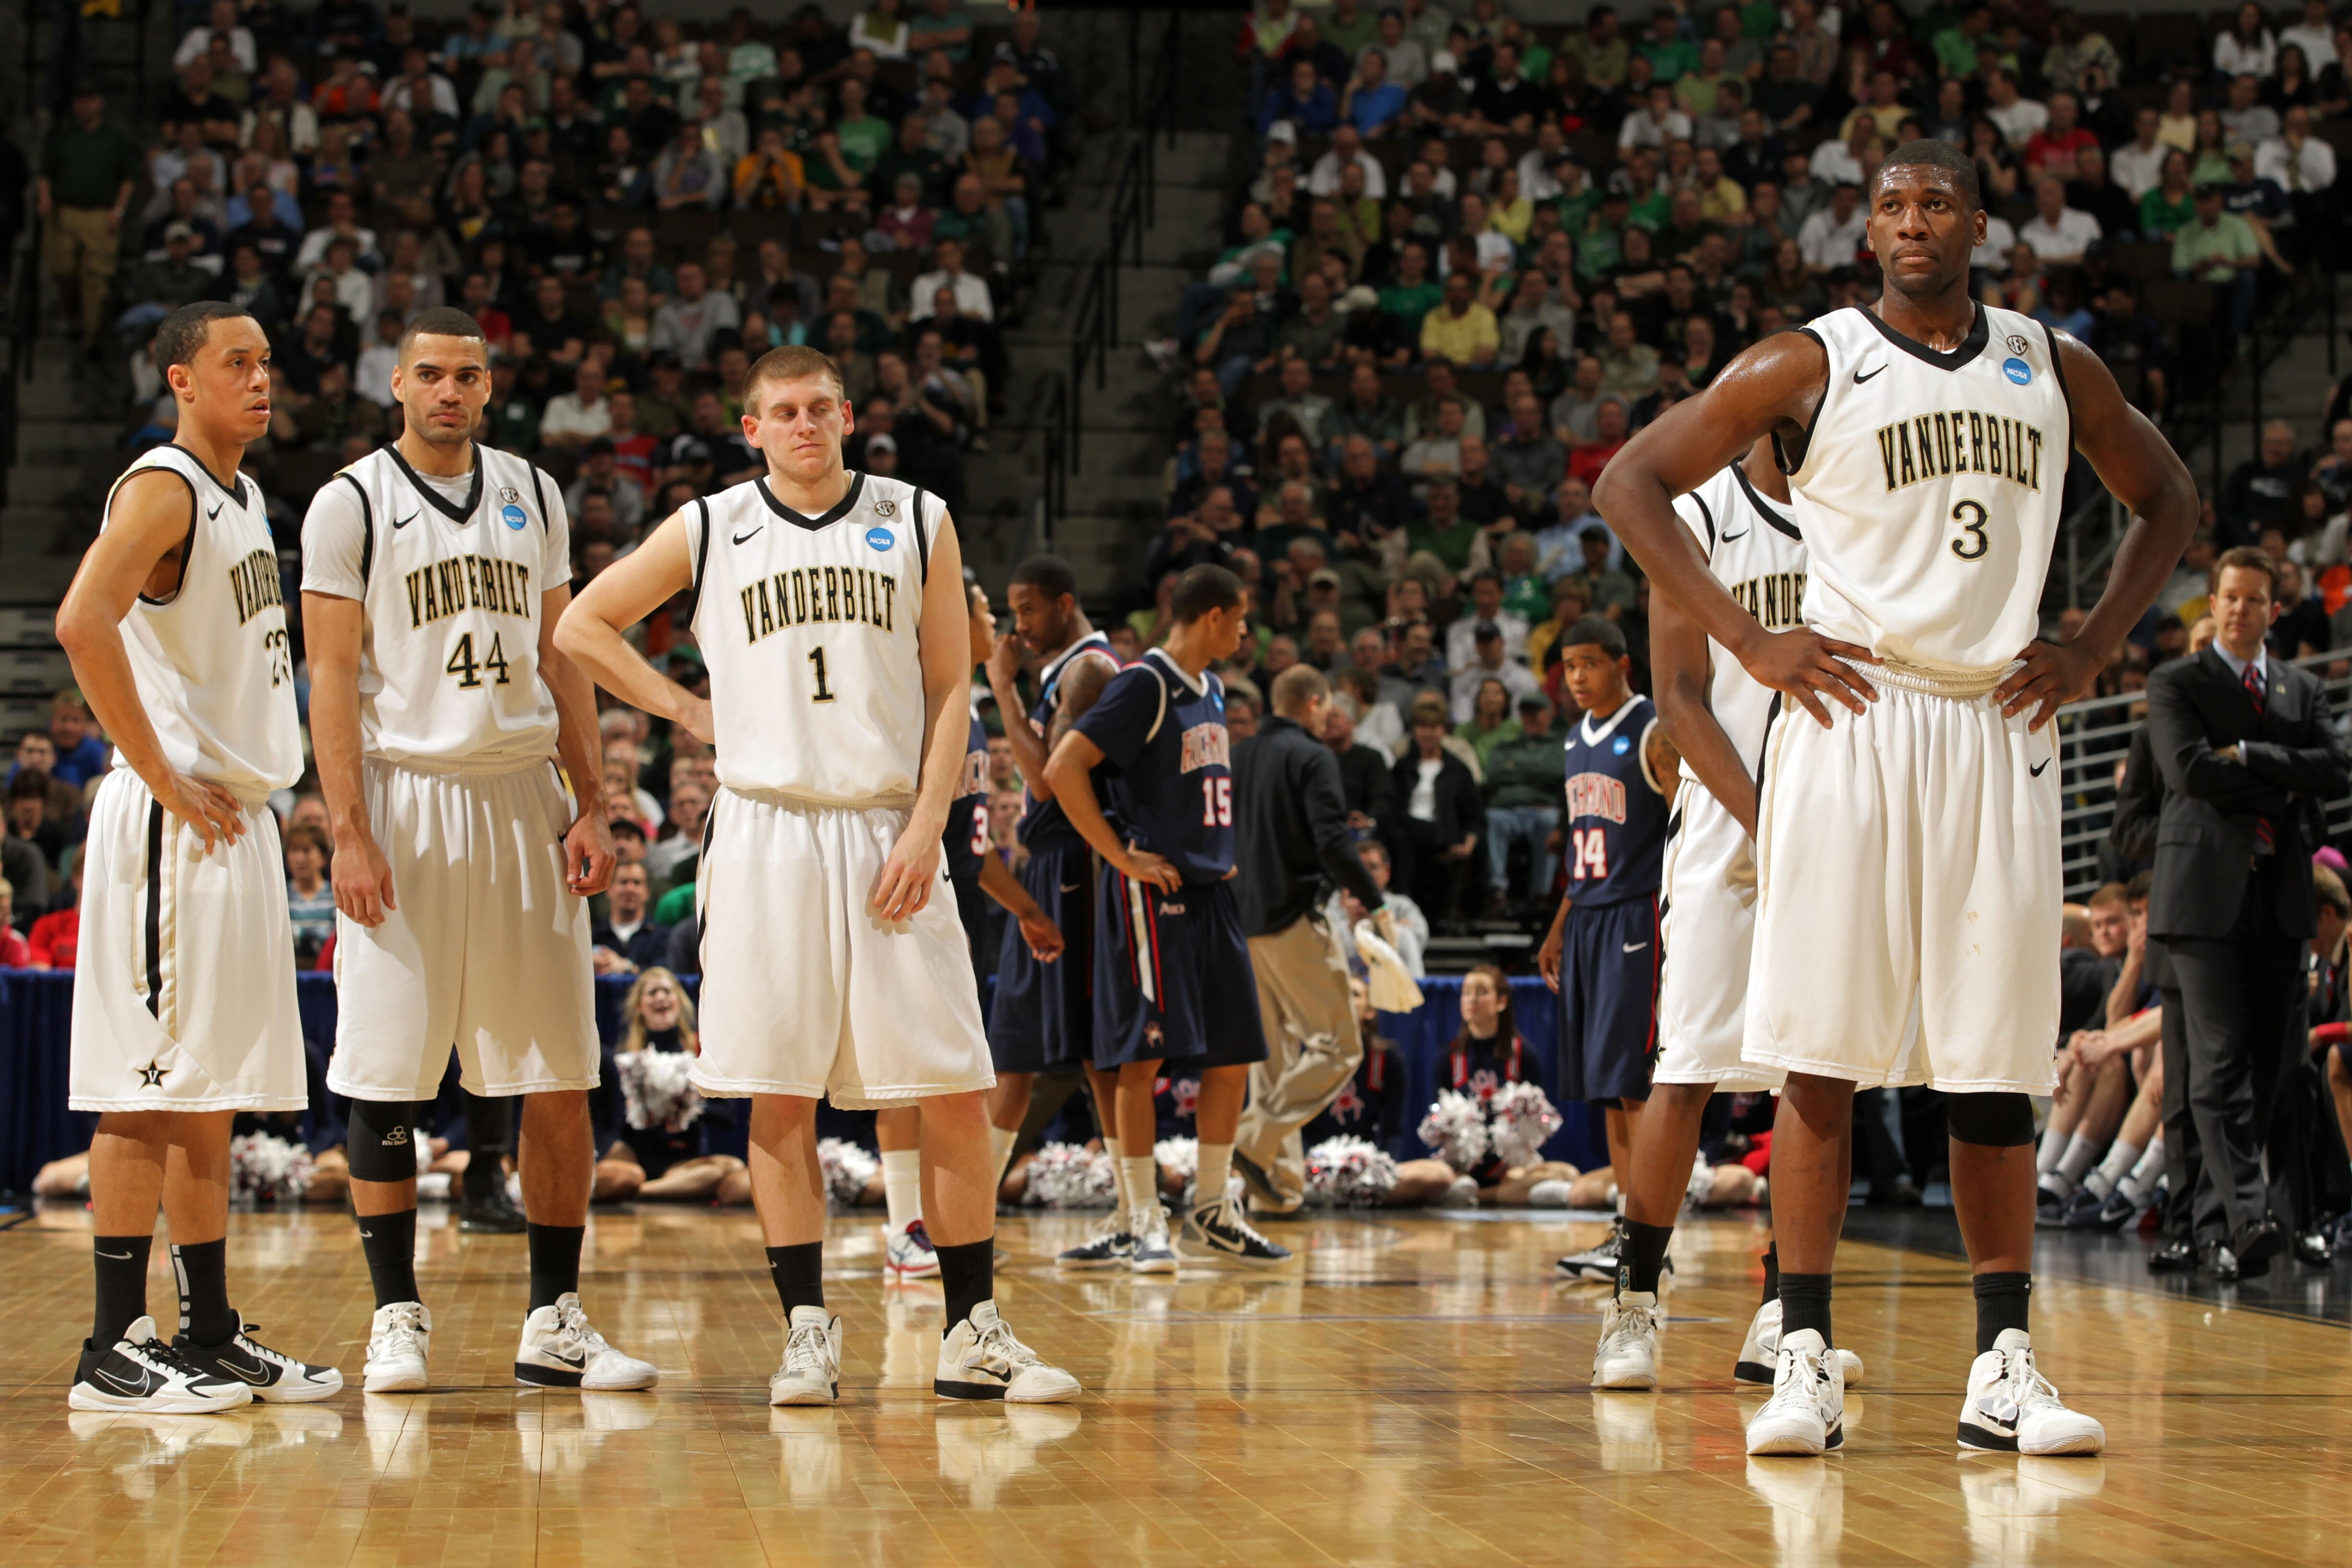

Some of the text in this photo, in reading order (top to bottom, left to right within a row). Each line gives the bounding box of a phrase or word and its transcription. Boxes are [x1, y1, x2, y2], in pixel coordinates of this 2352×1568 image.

[2007, 336, 2027, 354] SEC
[2007, 368, 2027, 380] NCAA
[1876, 410, 2043, 494] VANDERBILT
[501, 488, 518, 502] SEC
[505, 515, 524, 523] NCAA
[876, 502, 894, 515] SEC
[870, 537, 890, 545] NCAA
[1950, 498, 1992, 562] 3
[740, 565, 896, 646] VANDERBILT
[1731, 572, 1807, 629] ANDE
[263, 629, 290, 689] 23
[446, 630, 510, 690] 44
[808, 645, 835, 703] 1
[1202, 776, 1232, 827] 15
[970, 804, 989, 857] 3
[1572, 827, 1608, 880] 14
[147, 1070, 159, 1083] V
